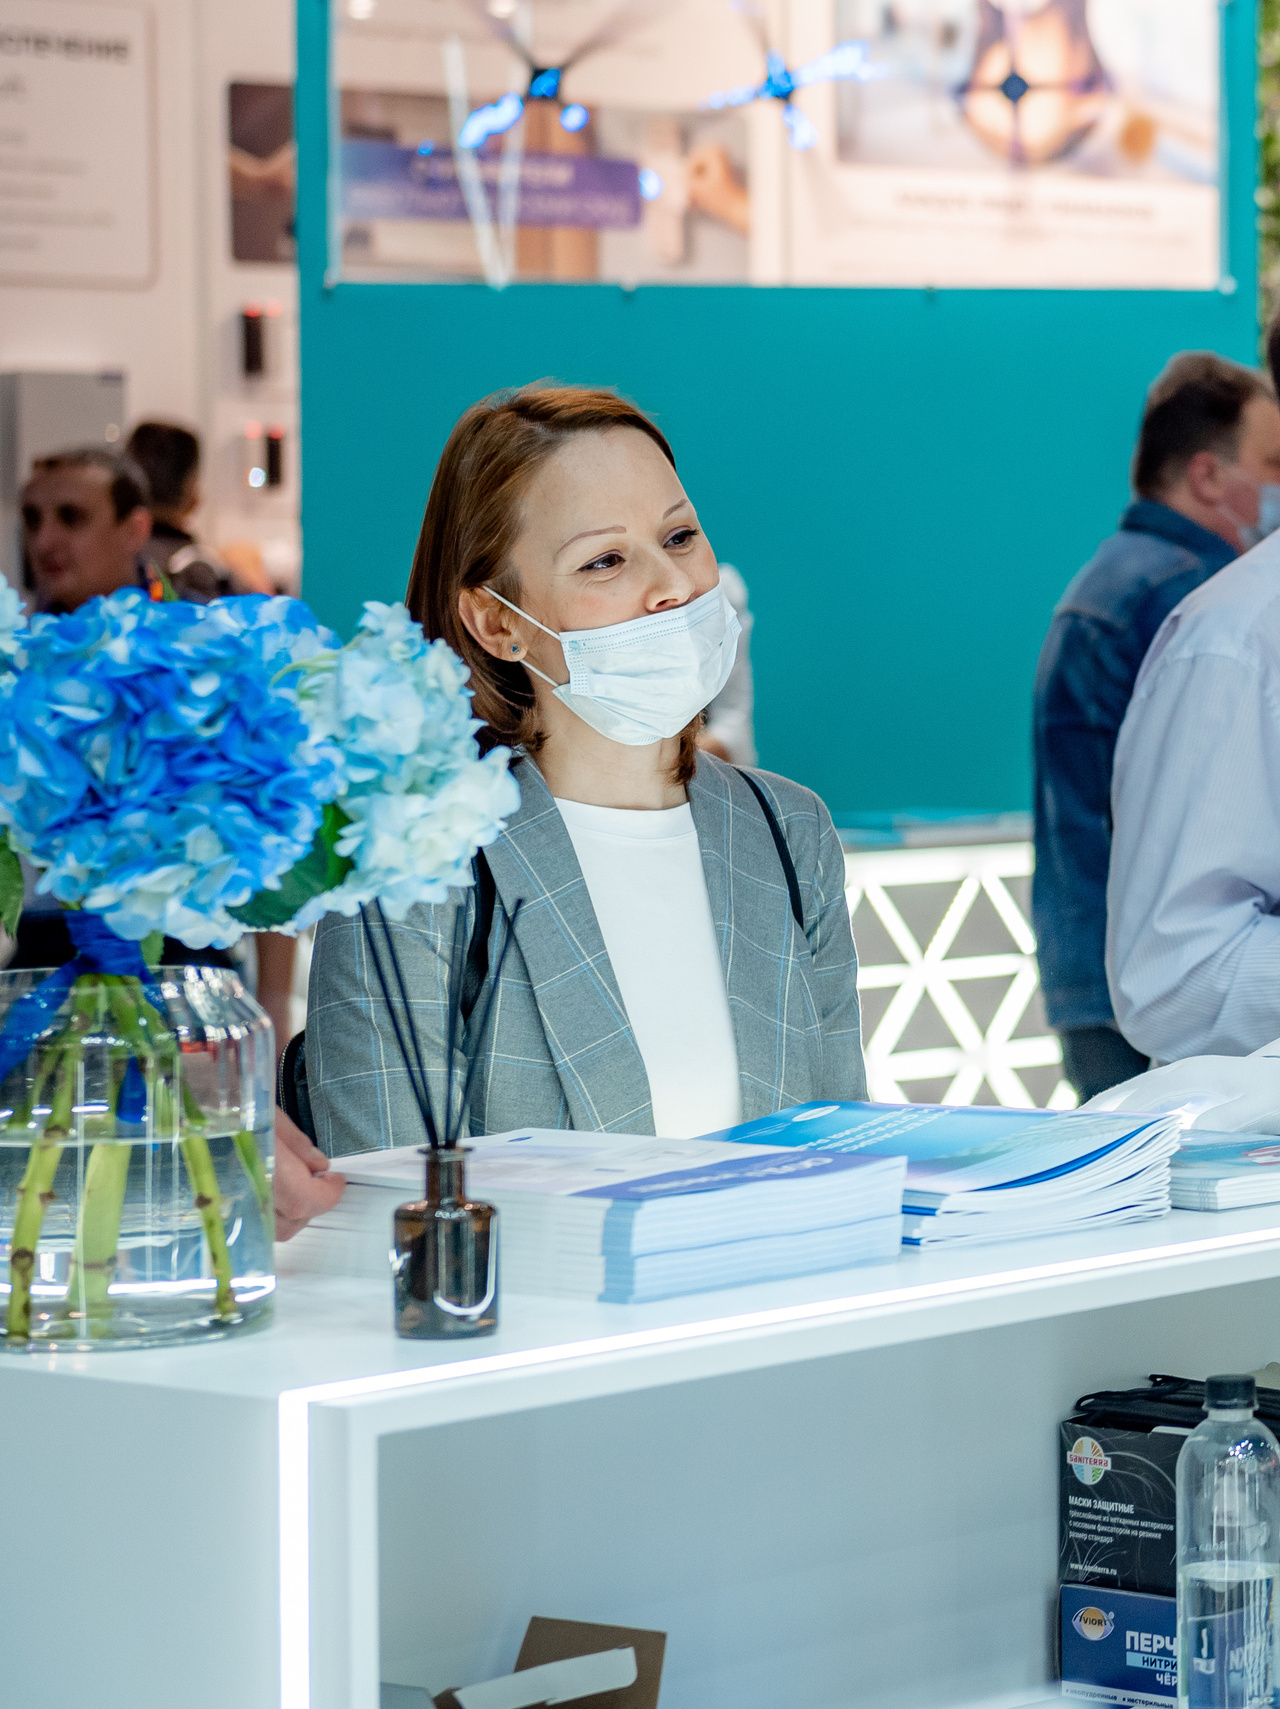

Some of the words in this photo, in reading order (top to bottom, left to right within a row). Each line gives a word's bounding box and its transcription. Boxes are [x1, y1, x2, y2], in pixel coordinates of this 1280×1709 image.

[1069, 1496, 1092, 1508] МАСКИ
[1093, 1499, 1134, 1514] ЗАЩИТНЫЕ
[1125, 1630, 1178, 1657] ПЕРЧ
[1142, 1656, 1178, 1671] НИТРИ
[1155, 1672, 1178, 1687] ЧЁР
